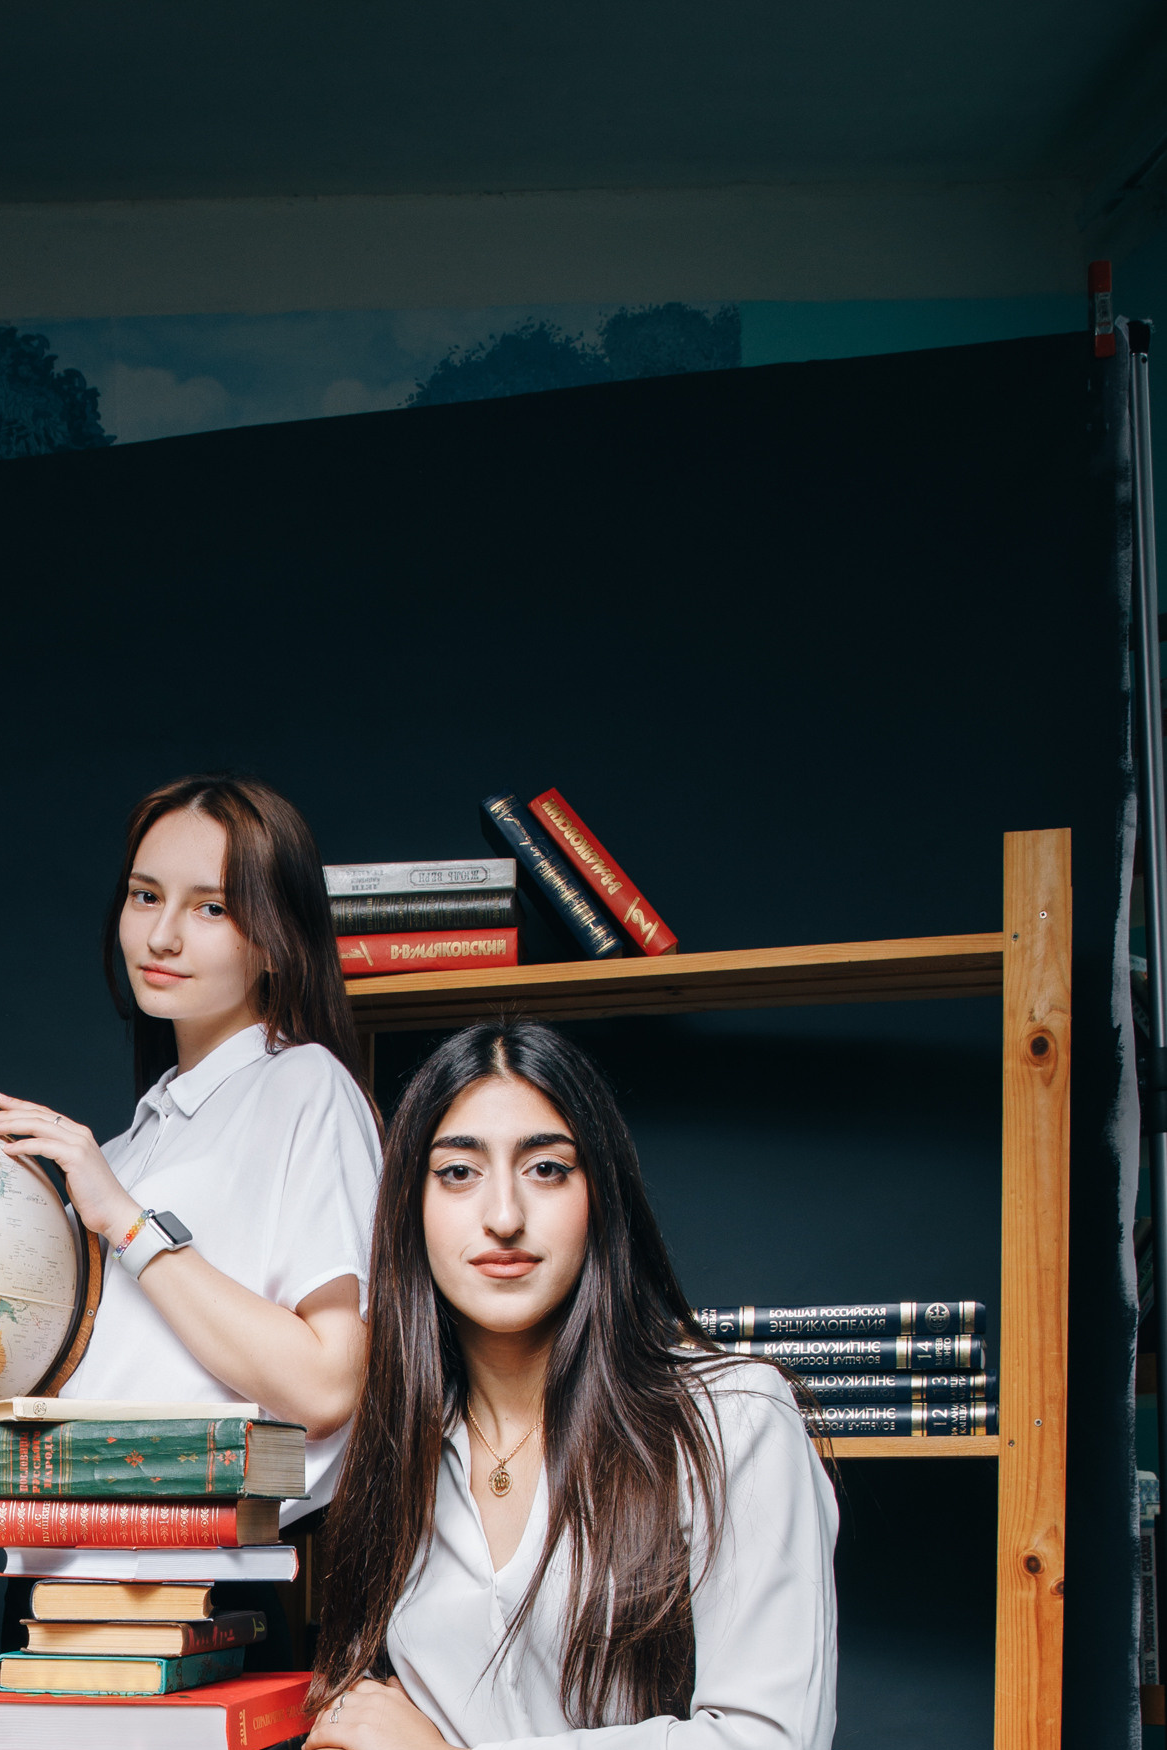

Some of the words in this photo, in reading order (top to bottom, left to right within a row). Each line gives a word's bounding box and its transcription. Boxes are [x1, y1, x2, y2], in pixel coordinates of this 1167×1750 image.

[769, 1308, 817, 1318] БОЛЬШАЯ
[820, 1306, 887, 1317] РОССИЙСКАЯ
[720, 1313, 734, 1333] 16
[769, 1318, 886, 1334] ЭНЦИКЛОПЕДИЯ
[763, 1341, 881, 1355] ЭНЦИКЛОПЕДИЯ
[917, 1341, 932, 1360] 14
[935, 1338, 943, 1366] КИРЕЕВ
[833, 1356, 881, 1364] БОЛЬШАЯ
[793, 1375, 896, 1386] ЭНЦИКЛОПЕД
[932, 1409, 948, 1427] 12
[19, 1432, 30, 1492] ПОСЛОВИЦЫ
[32, 1431, 41, 1493] РУССКОГО
[44, 1435, 55, 1489] НАРОДА
